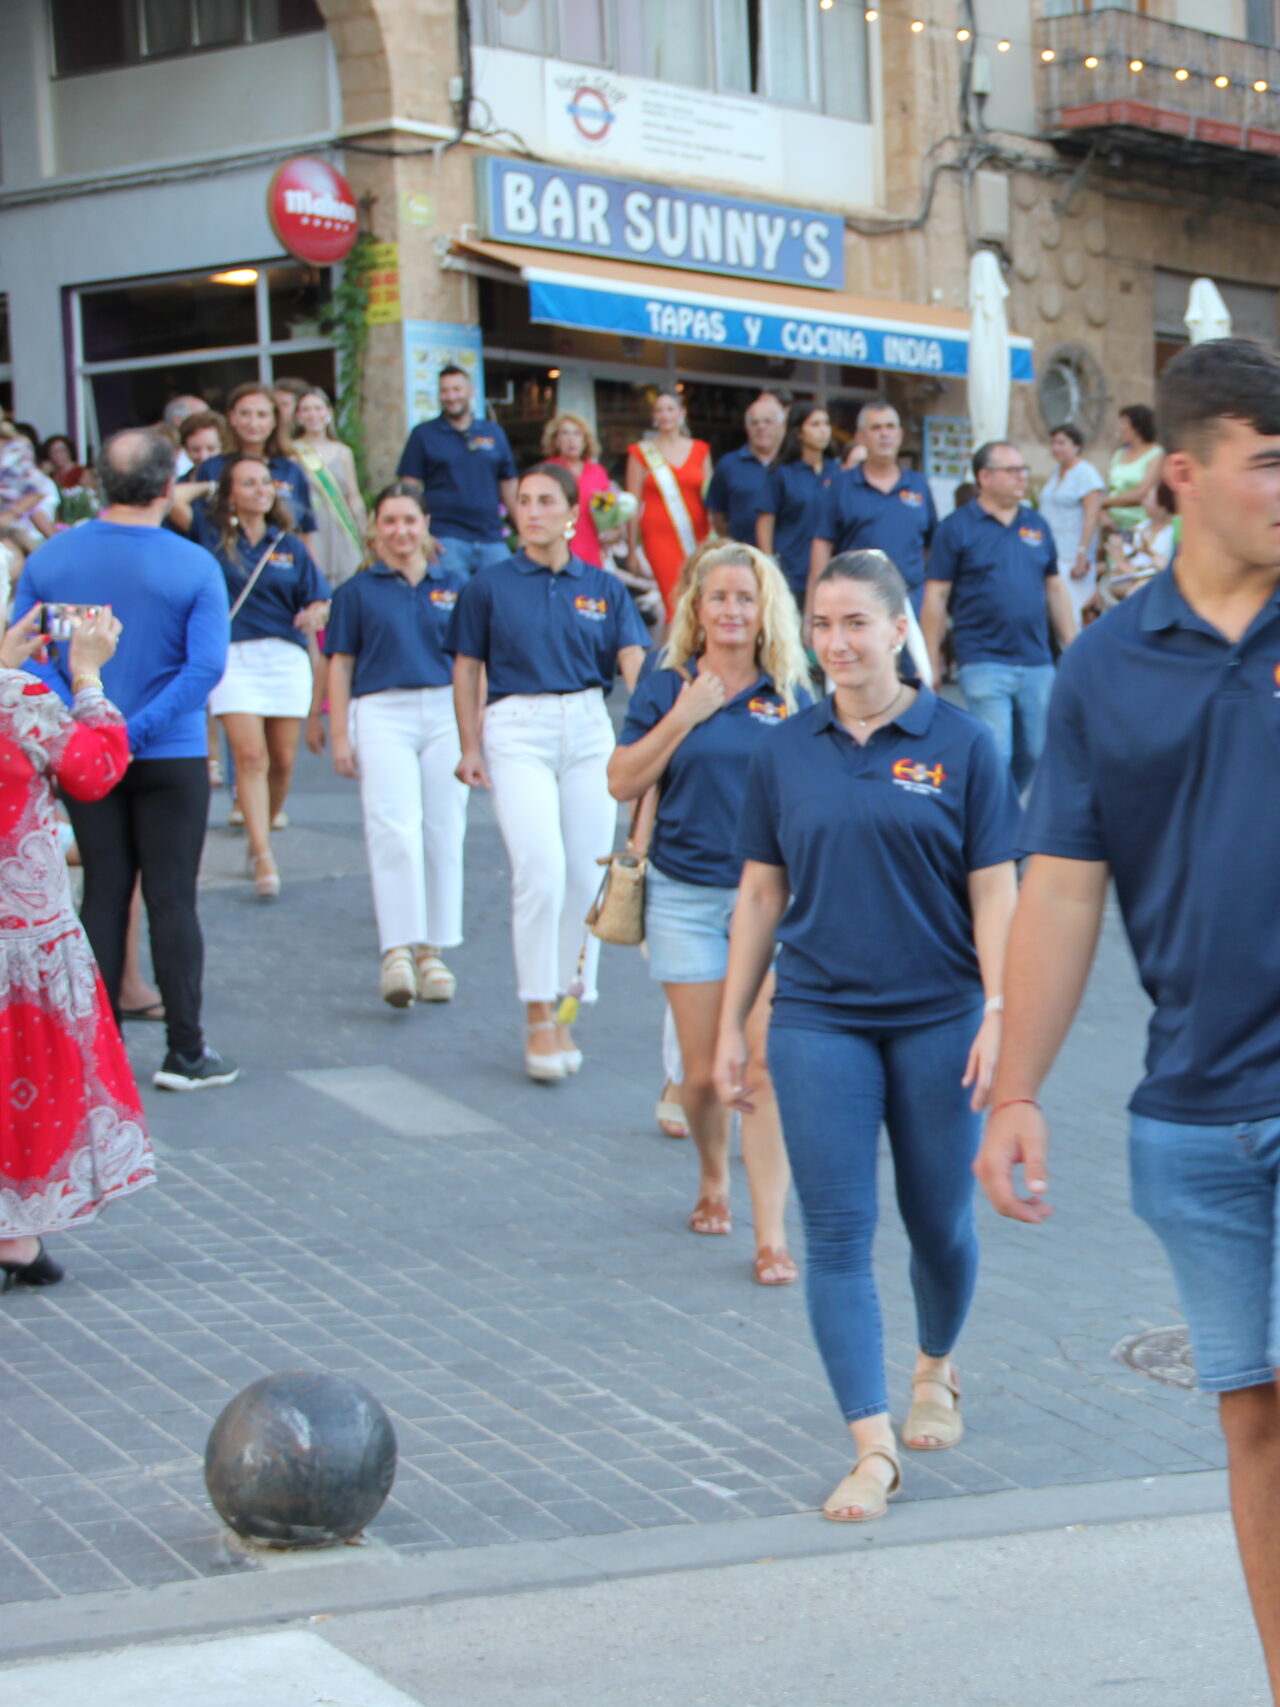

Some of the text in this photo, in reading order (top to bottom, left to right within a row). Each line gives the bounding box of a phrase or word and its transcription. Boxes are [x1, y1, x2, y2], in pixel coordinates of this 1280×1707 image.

[503, 170, 832, 280] BAR SUNNY'S
[646, 301, 944, 371] TAPAS Y COCINA INDIA
